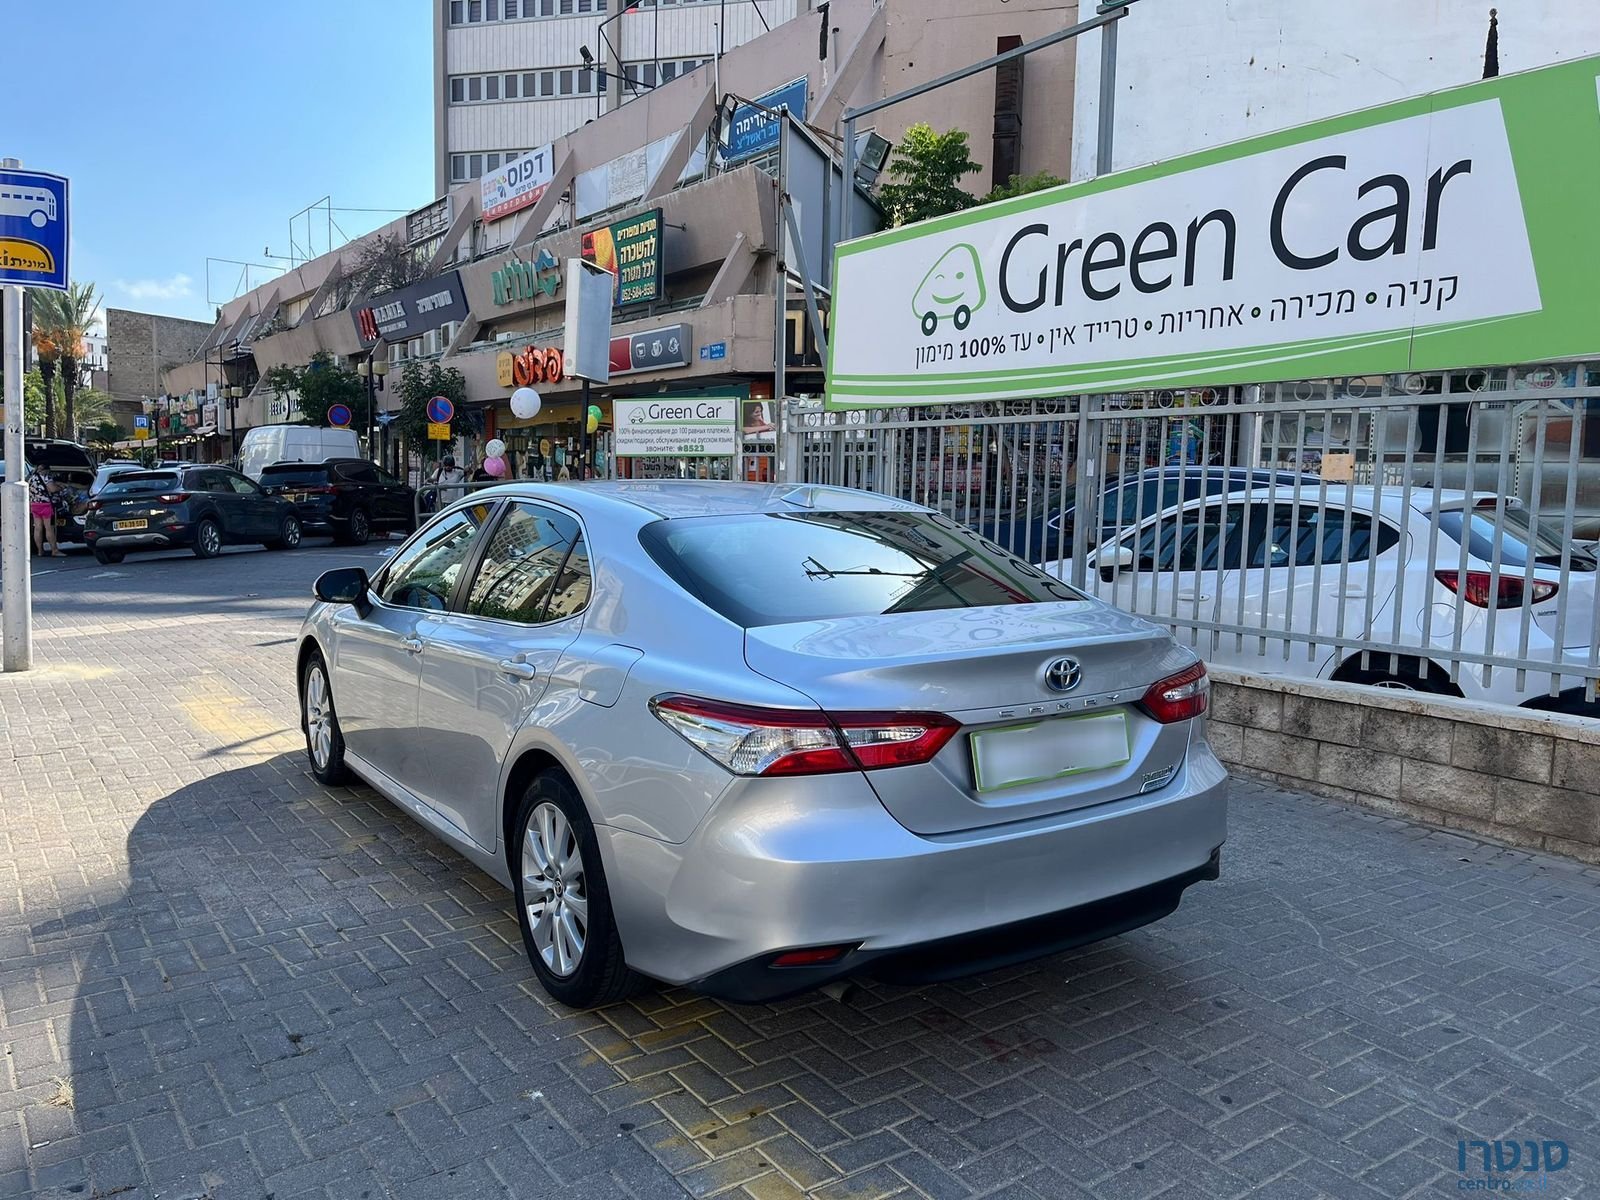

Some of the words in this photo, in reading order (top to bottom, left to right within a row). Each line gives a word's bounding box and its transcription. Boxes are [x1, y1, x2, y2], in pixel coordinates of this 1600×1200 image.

[507, 152, 544, 188] דפוס
[620, 234, 657, 264] להשכרה
[998, 208, 1237, 314] Green
[1269, 155, 1472, 270] Car
[10, 256, 46, 270] מונית
[1270, 289, 1355, 322] מכירה
[1386, 275, 1459, 312] קניה
[1083, 317, 1139, 344] טרייד
[1158, 303, 1245, 335] אחריות
[958, 335, 1006, 359] 100%
[1010, 331, 1032, 353] עד
[1048, 325, 1077, 355] אין
[915, 343, 954, 370] מימון
[649, 403, 692, 420] Green
[696, 402, 722, 419] Car
